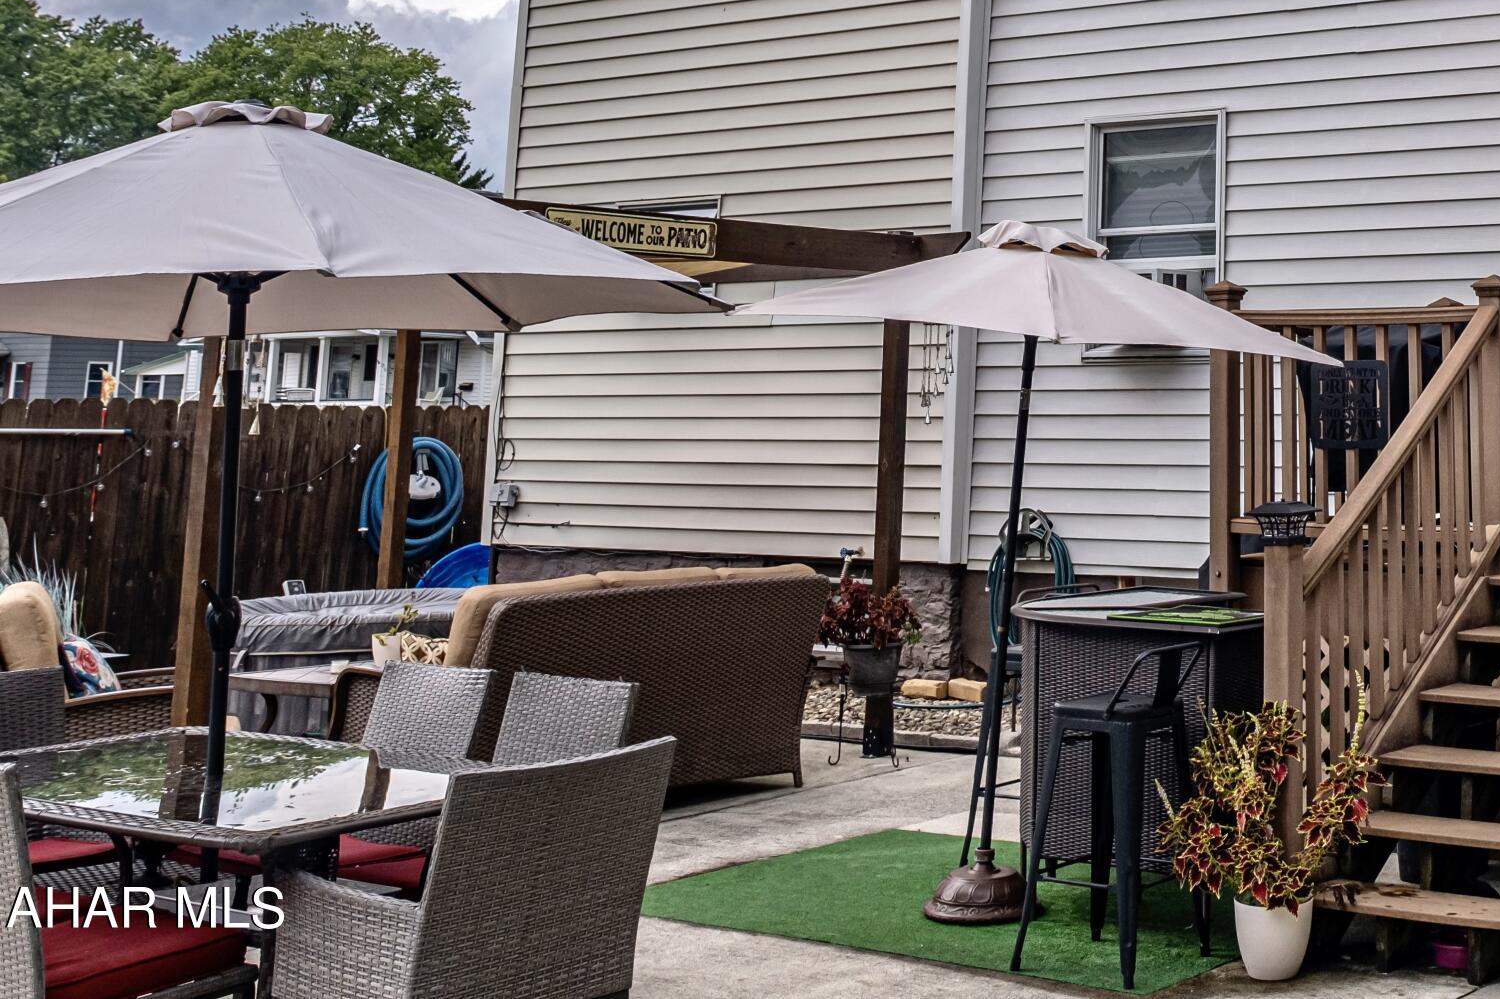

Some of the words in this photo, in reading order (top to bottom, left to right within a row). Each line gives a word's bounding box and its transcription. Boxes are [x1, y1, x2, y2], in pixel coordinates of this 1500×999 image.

[581, 218, 645, 244] WELCOME
[650, 225, 662, 235] TO
[667, 226, 708, 249] PATIO
[646, 236, 665, 246] OUR
[1319, 378, 1370, 394] DRINK
[1343, 409, 1381, 418] SMOKE
[1319, 419, 1382, 441] MEAT
